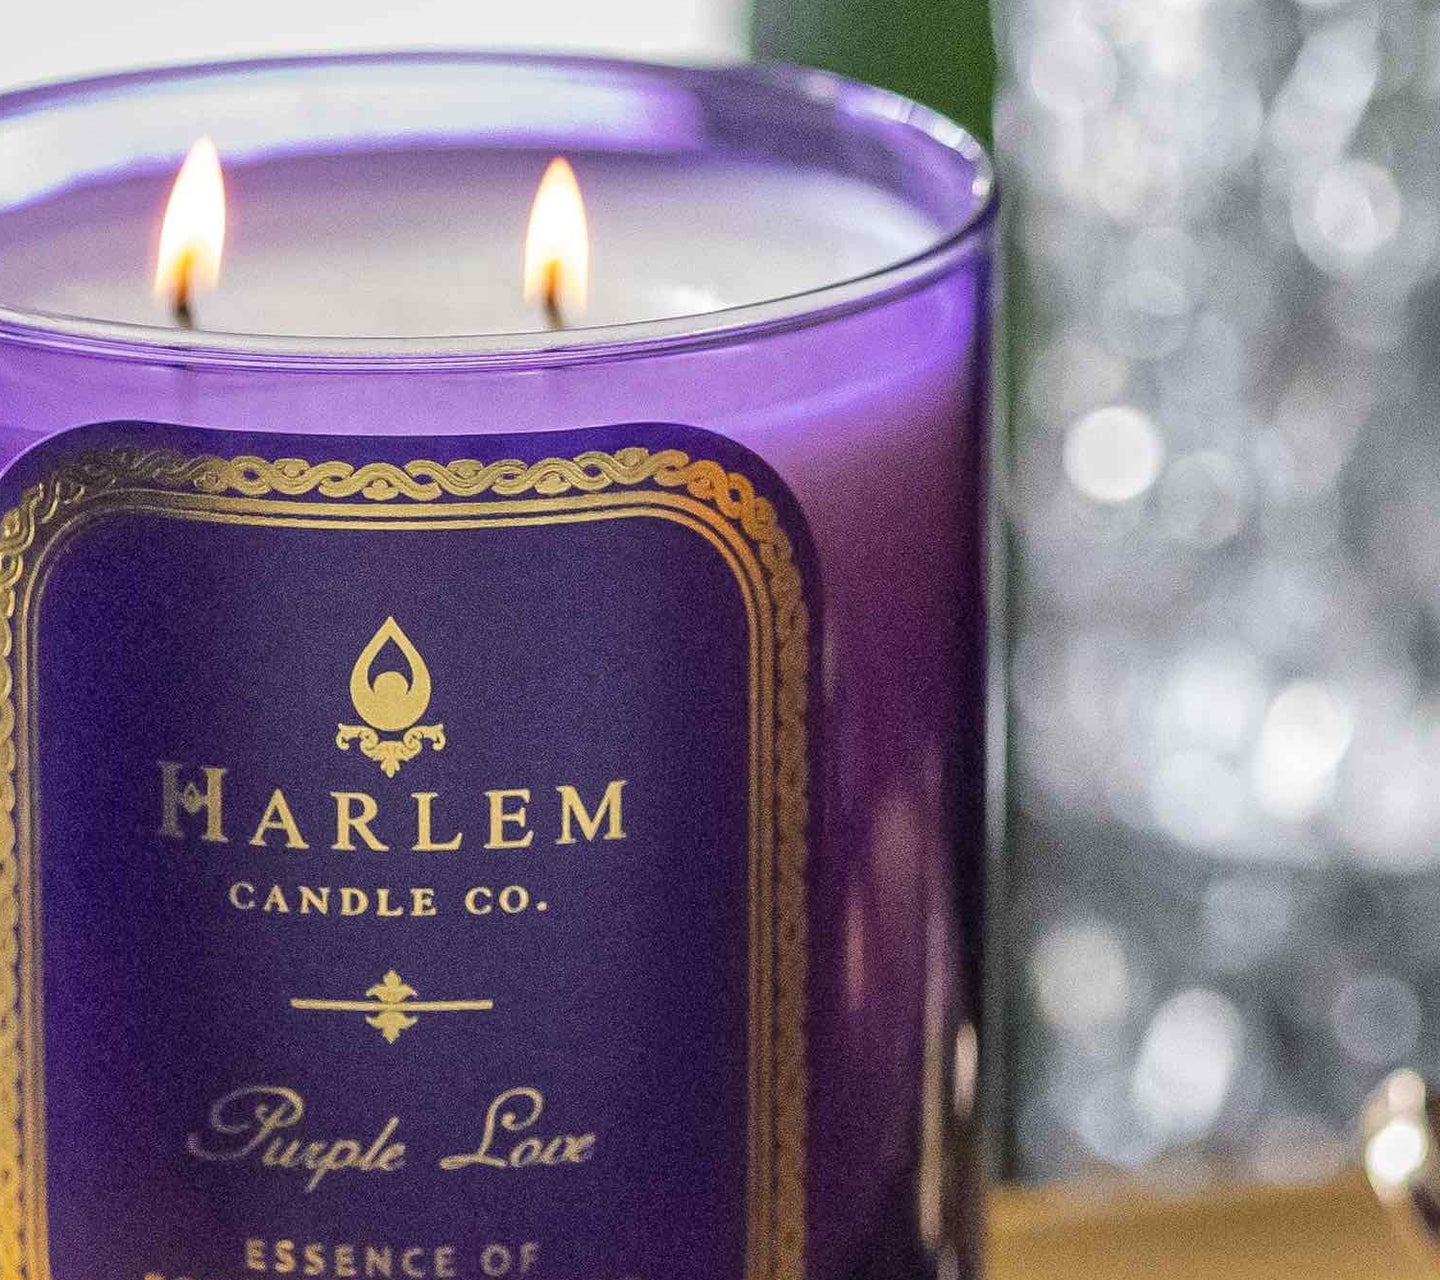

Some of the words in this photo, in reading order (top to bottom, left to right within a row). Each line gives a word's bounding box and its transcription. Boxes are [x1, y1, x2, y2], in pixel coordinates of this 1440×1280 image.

[160, 761, 628, 853] HARLEM
[229, 881, 437, 918] CANDLE
[465, 885, 549, 916] CO.
[185, 1085, 408, 1194] Purple
[440, 1086, 597, 1171] Love
[245, 1238, 458, 1280] ESSENCE
[480, 1241, 541, 1277] OF
